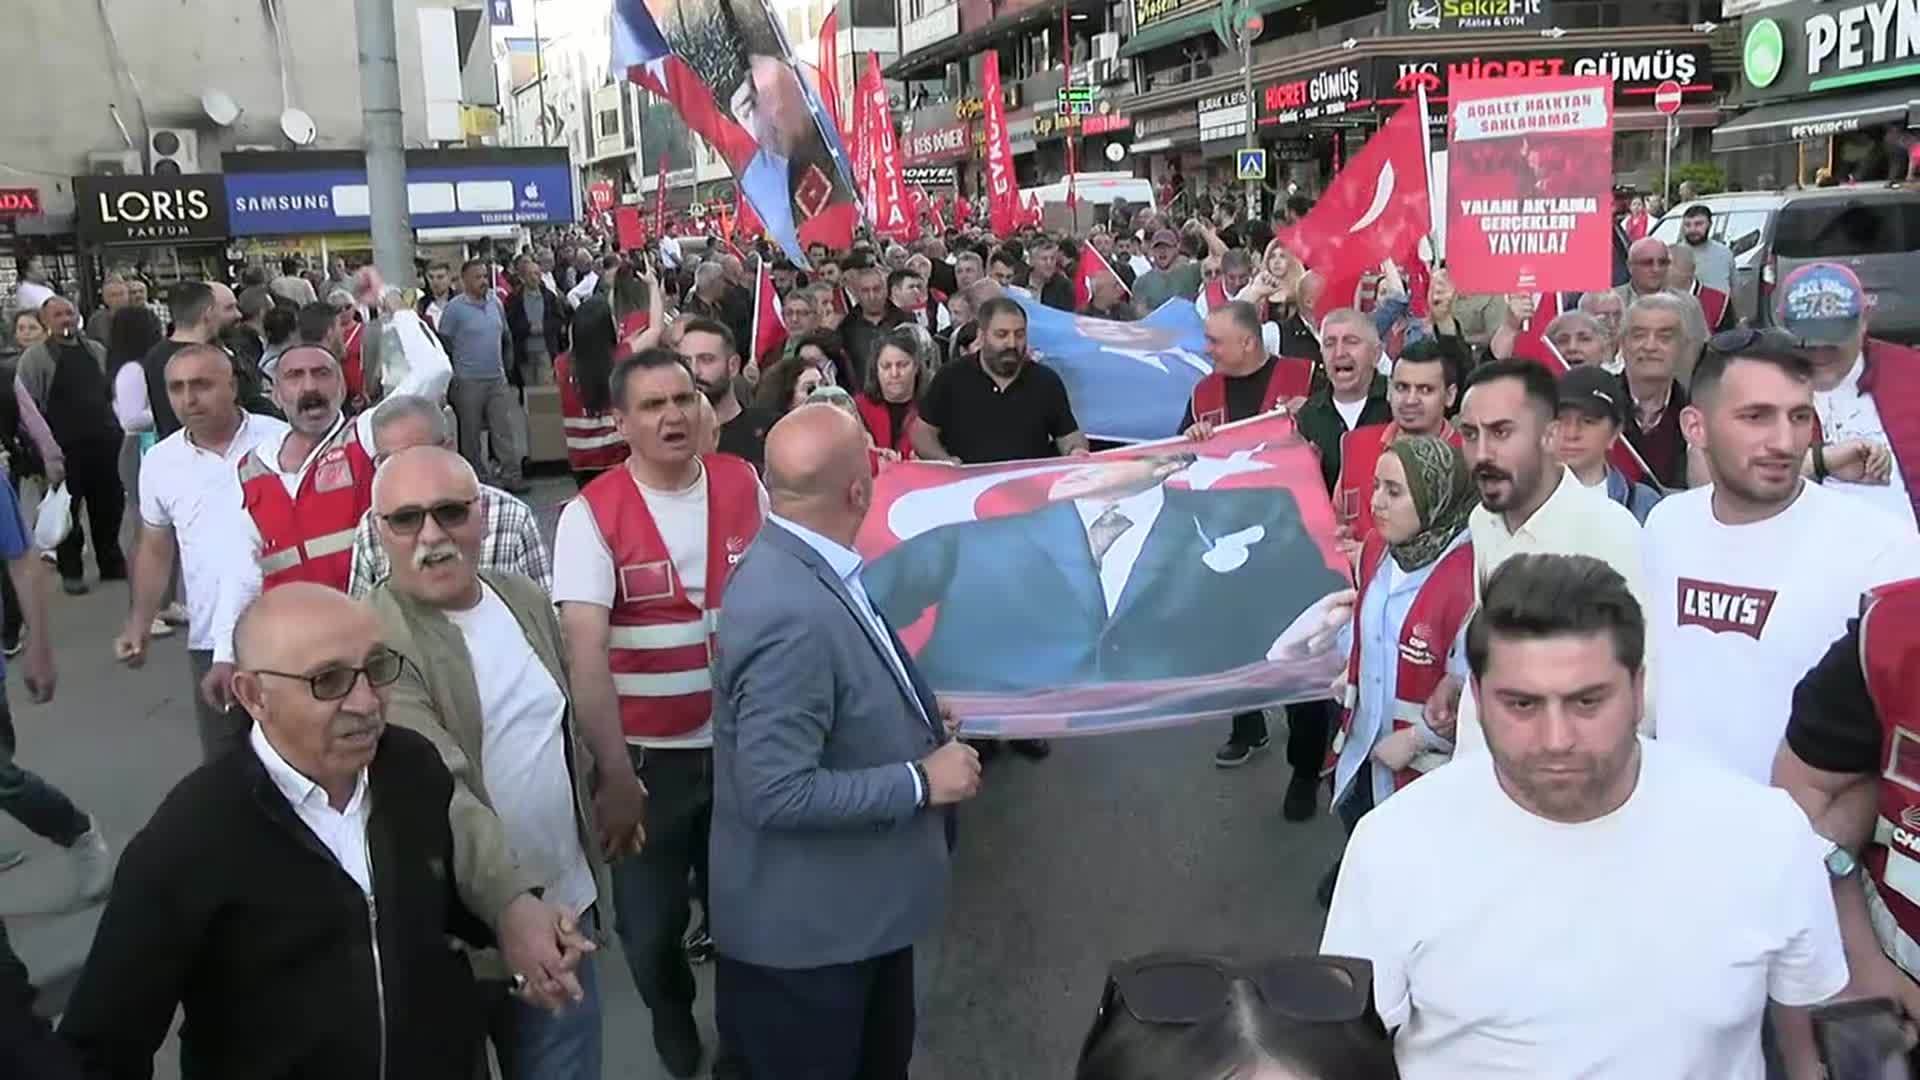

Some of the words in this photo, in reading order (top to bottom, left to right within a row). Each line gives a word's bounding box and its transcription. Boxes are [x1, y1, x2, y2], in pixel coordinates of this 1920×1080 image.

[1574, 49, 1697, 85] GÜMÜŞ
[1265, 81, 1307, 112] HİCRET
[1309, 67, 1359, 102] GÜMÜŞ
[1467, 101, 1520, 119] ADALET
[1525, 94, 1592, 111] HALKTAN
[1481, 112, 1581, 133] SAKLANAMAZ
[99, 188, 210, 223] LORIS
[235, 194, 329, 212] SAMSUNG
[1460, 199, 1520, 216] YALANI
[127, 226, 190, 238] PARFUM
[1488, 232, 1569, 256] YAYINLA!
[1683, 588, 1761, 625] LEVI'S
